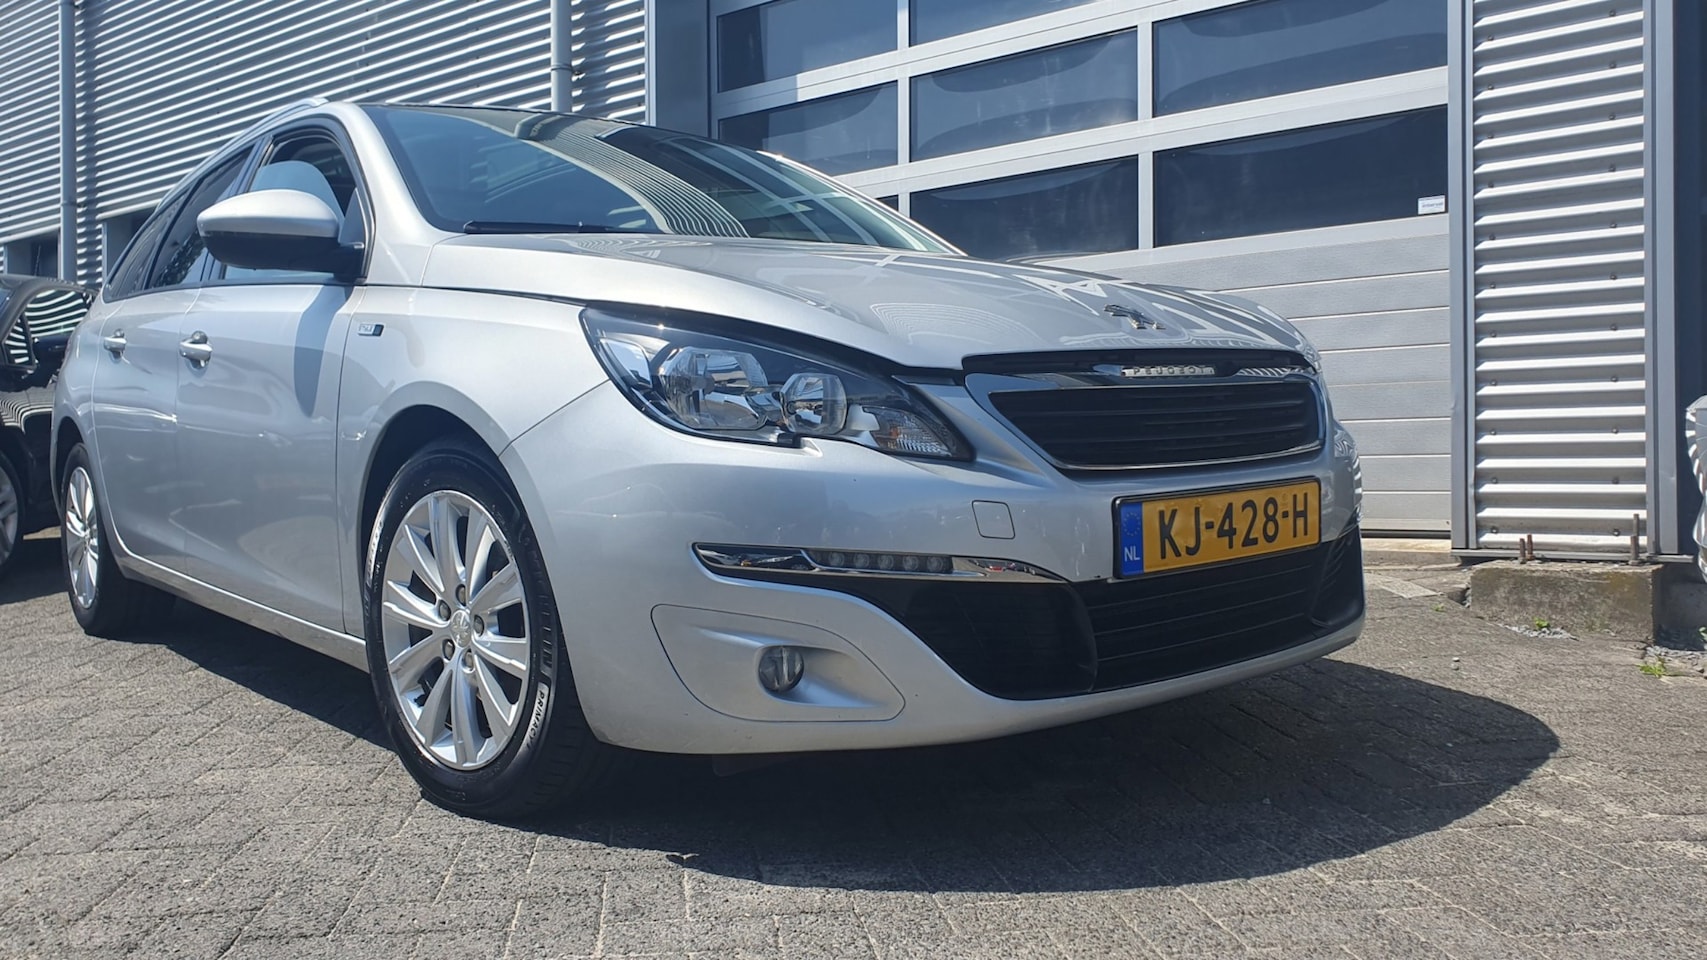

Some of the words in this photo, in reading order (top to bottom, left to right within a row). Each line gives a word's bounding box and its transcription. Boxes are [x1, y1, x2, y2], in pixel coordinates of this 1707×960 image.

[1132, 365, 1206, 376] PEUGEOT
[1158, 492, 1309, 560] KJ-428-H
[1124, 546, 1141, 562] NL
